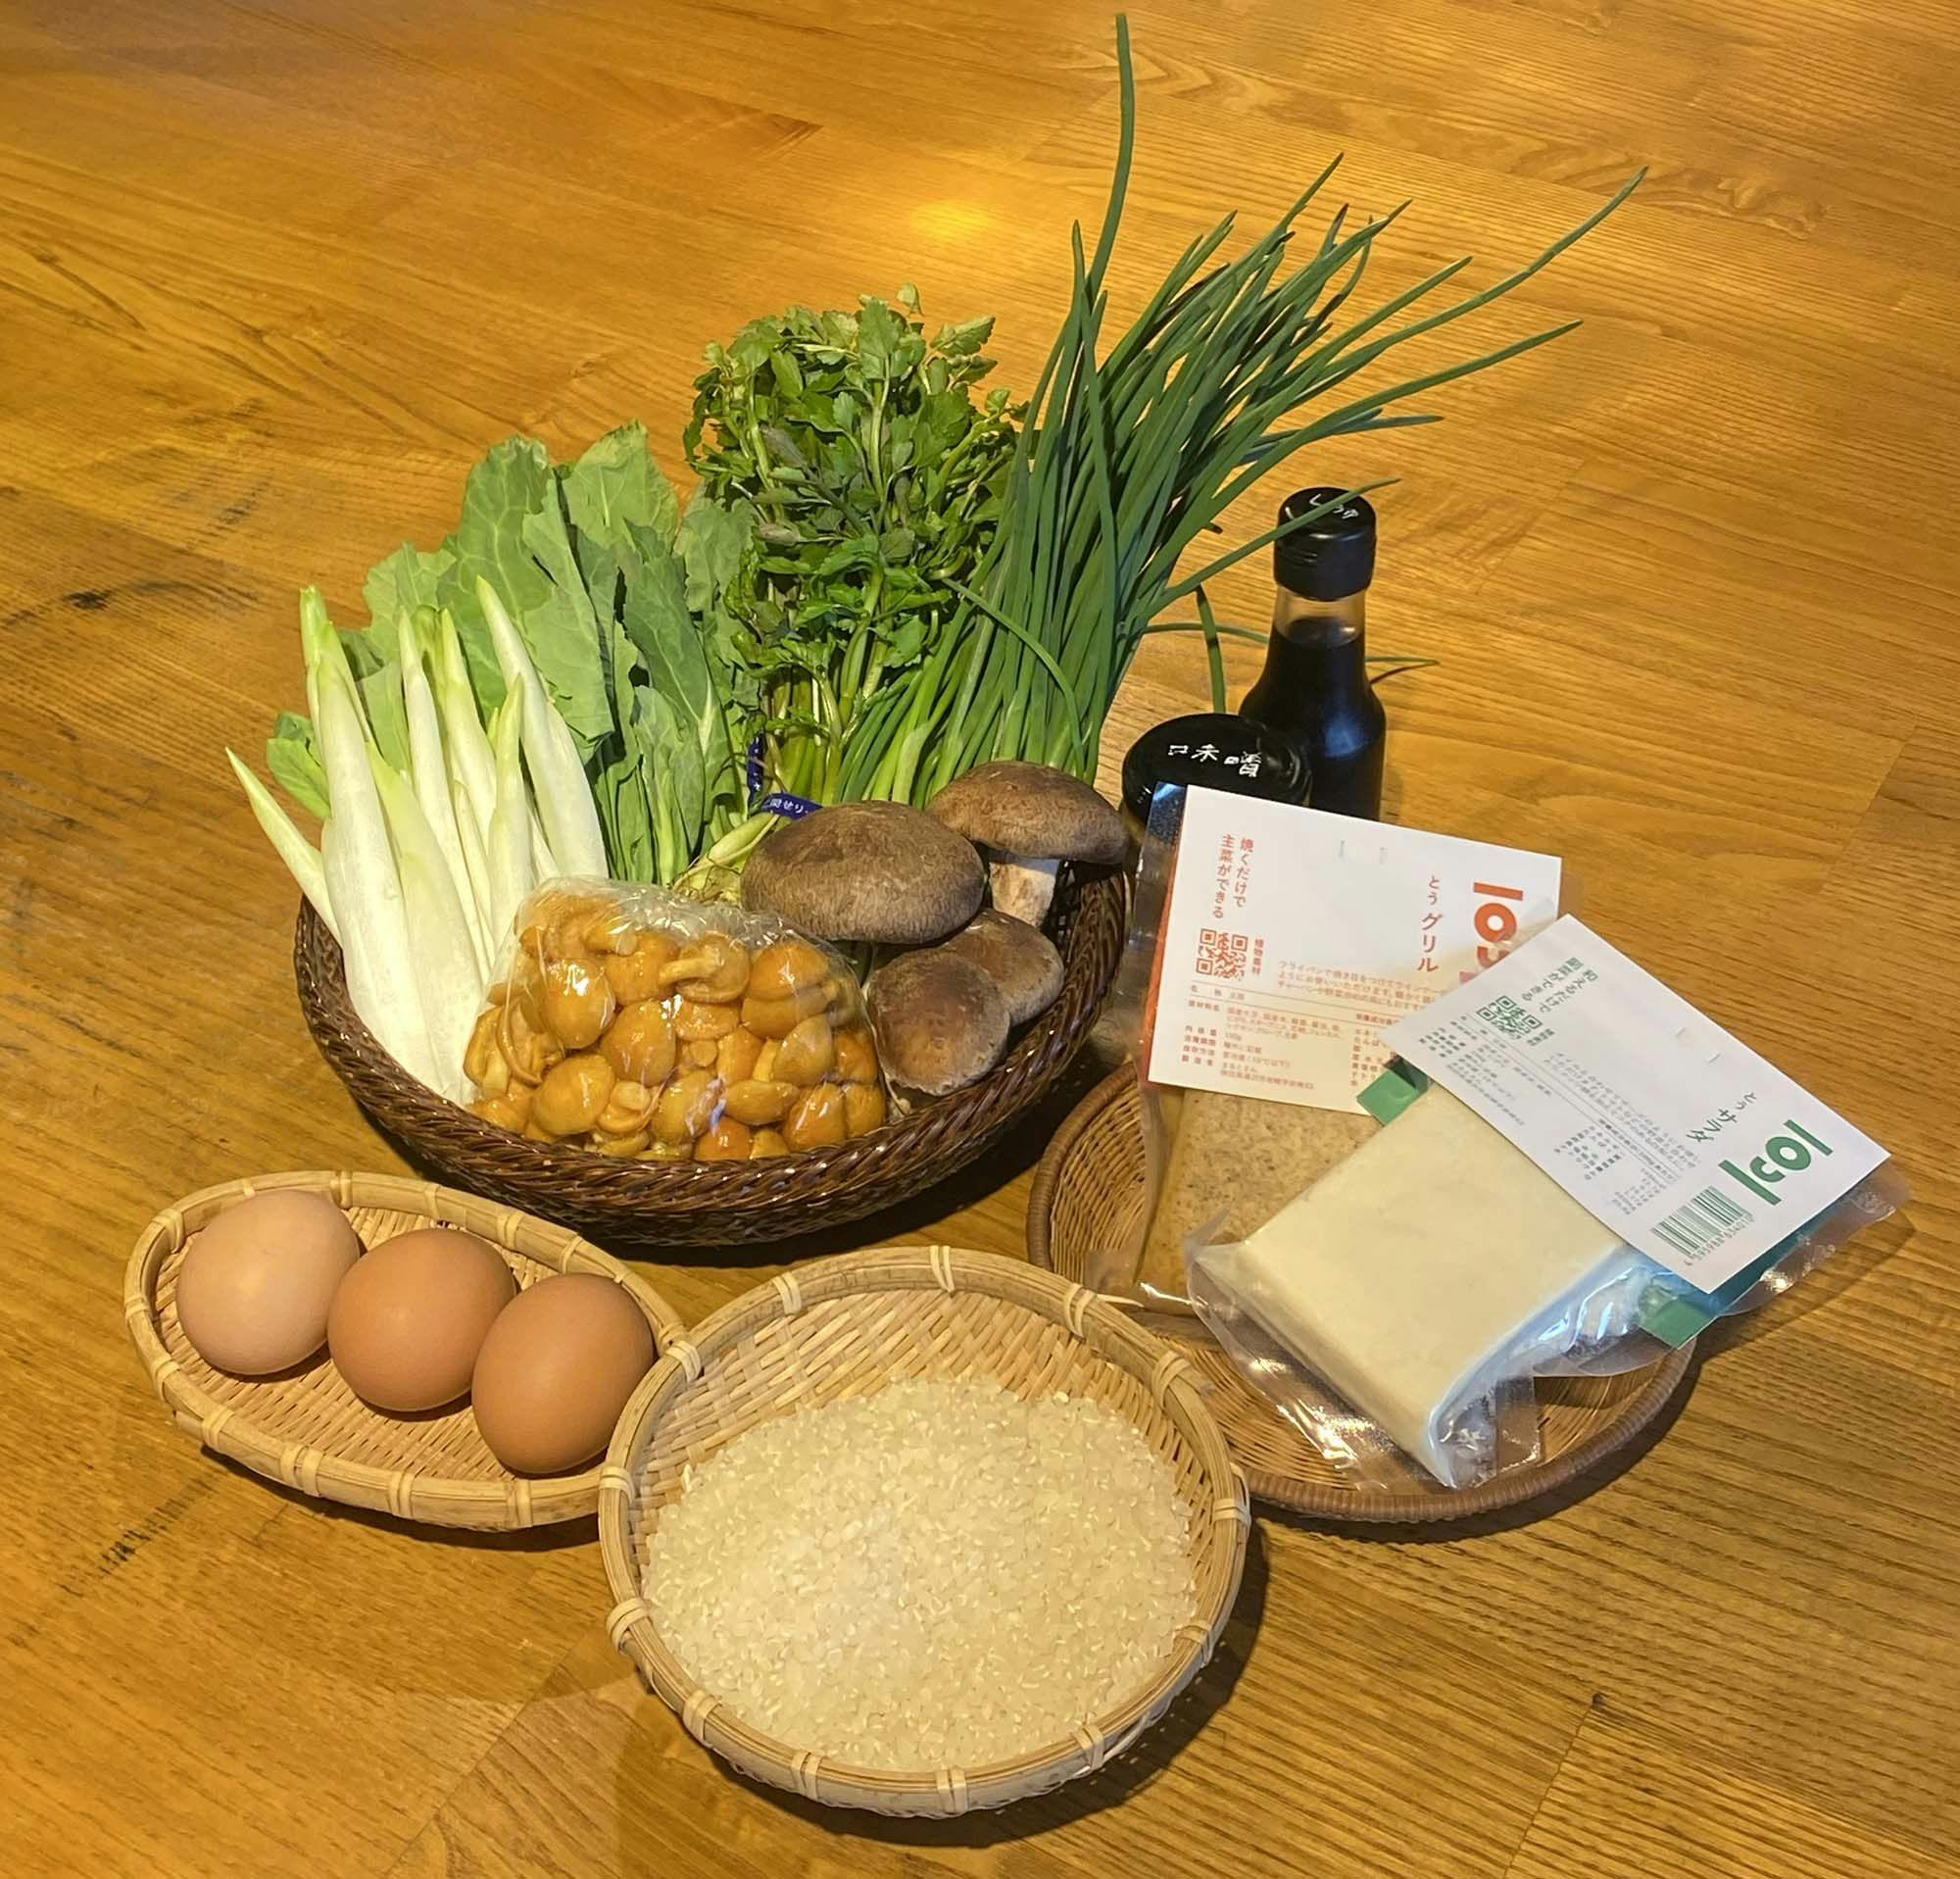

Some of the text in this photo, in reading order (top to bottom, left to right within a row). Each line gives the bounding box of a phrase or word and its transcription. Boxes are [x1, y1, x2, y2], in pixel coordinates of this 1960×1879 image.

[1211, 833, 1235, 919] 主菜ができる
[1234, 837, 1253, 908] 焼くだけで
